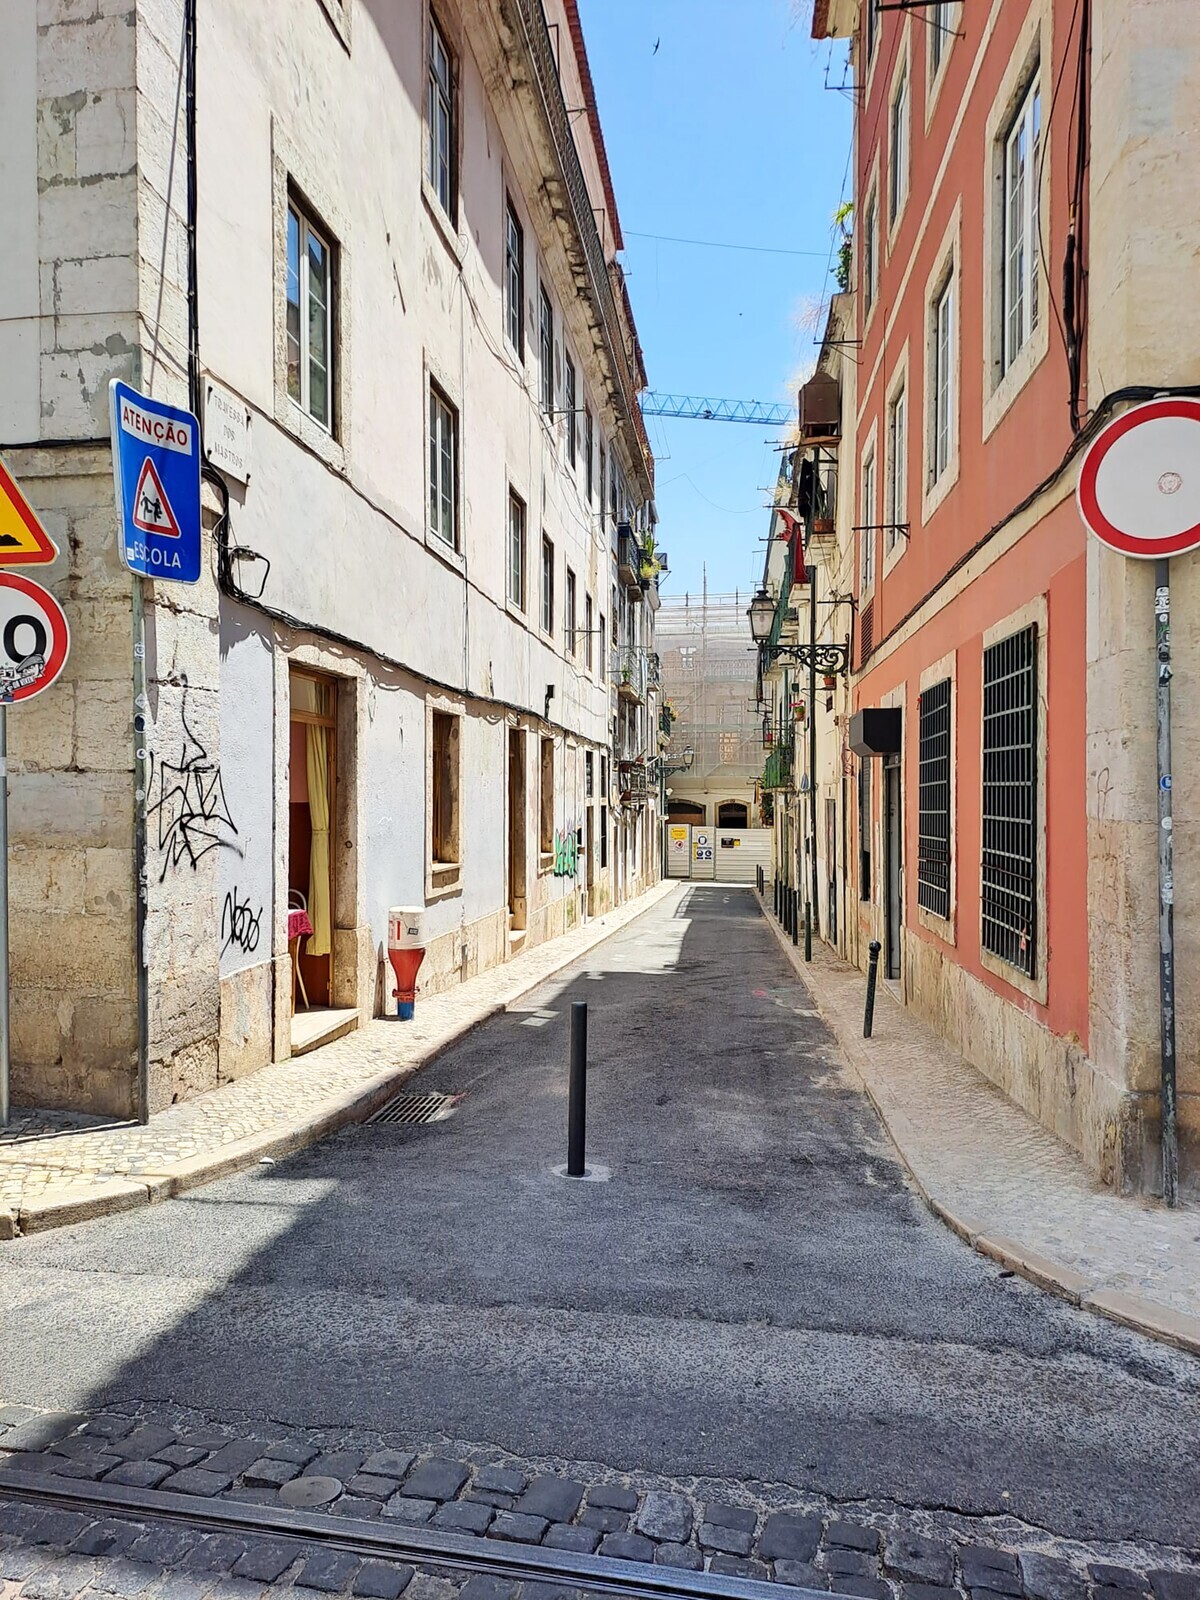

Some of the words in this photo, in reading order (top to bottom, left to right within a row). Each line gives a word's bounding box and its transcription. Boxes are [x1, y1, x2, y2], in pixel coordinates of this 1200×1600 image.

[123, 405, 188, 446] ATENÇÃO
[223, 424, 236, 442] DOS
[133, 540, 182, 569] ESCOLA
